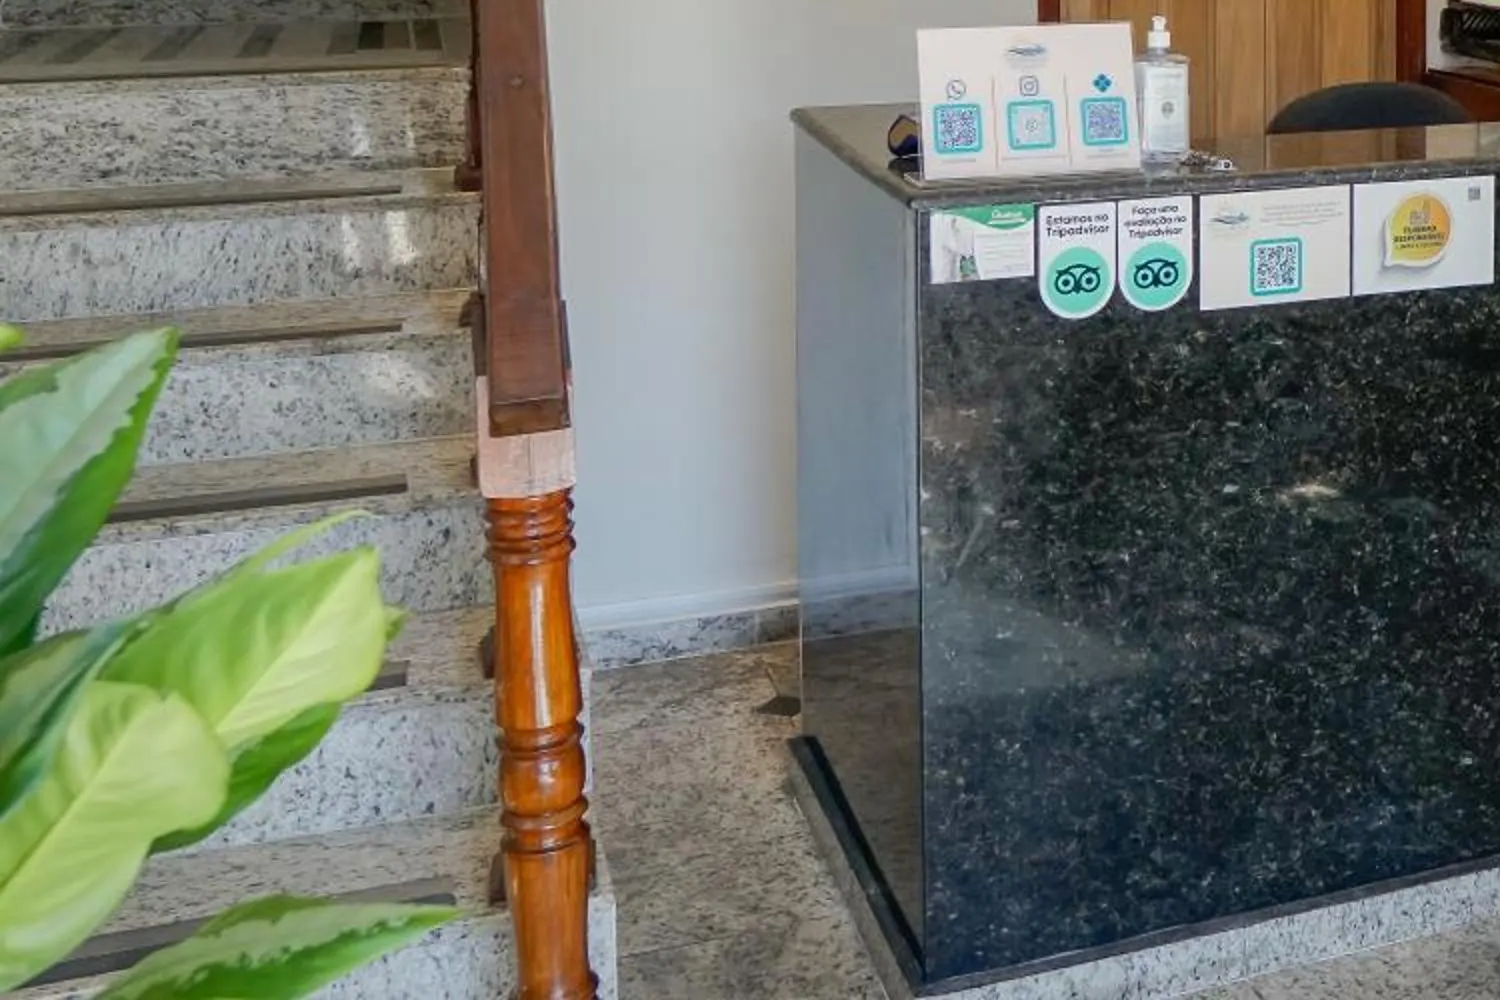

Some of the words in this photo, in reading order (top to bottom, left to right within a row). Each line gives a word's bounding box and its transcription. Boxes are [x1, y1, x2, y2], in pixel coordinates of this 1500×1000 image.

[1132, 205, 1157, 215] Faça
[1046, 214, 1093, 225] Estamos
[1094, 213, 1109, 222] no
[1174, 215, 1187, 223] no
[1046, 225, 1110, 238] Tripadvisor
[1129, 226, 1184, 239] Tripadvisor
